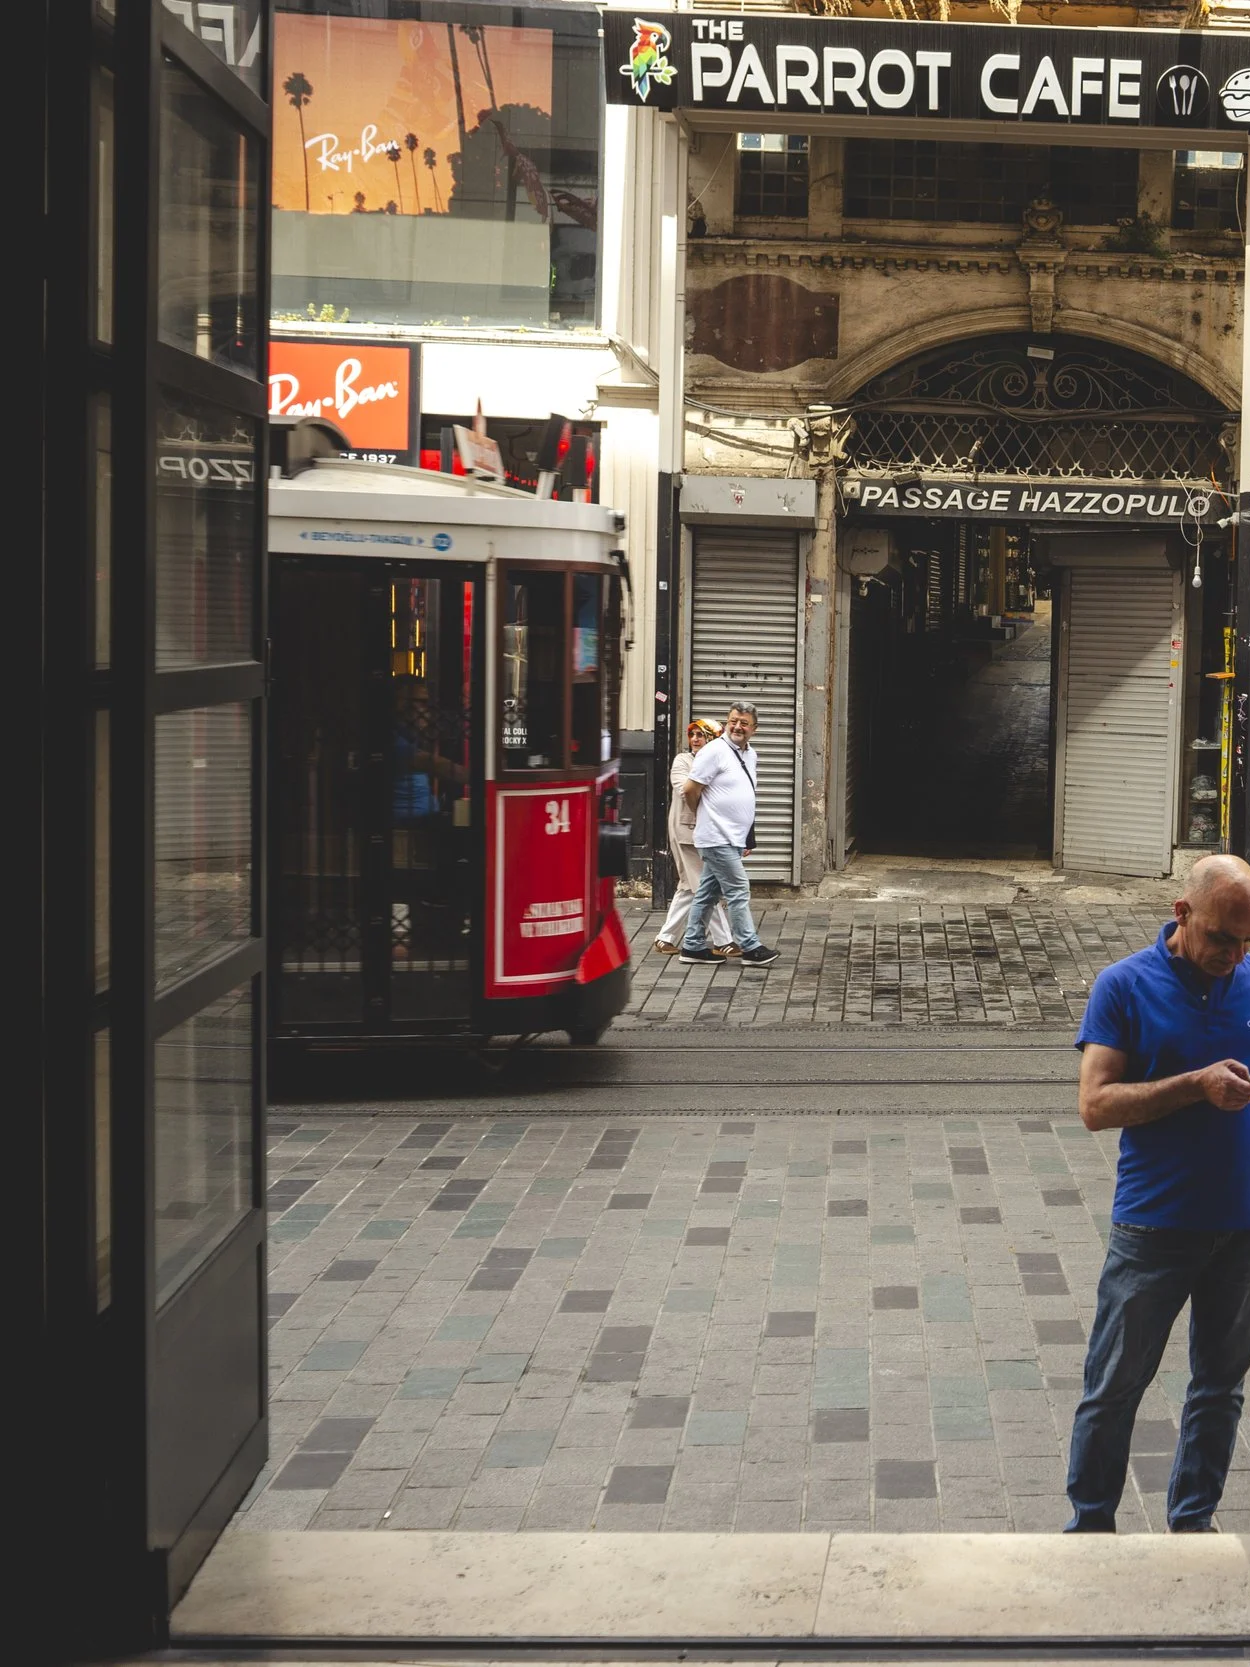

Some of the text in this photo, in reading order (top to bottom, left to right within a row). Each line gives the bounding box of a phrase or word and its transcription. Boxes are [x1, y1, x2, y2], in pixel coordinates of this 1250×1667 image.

[692, 19, 744, 41] THE
[691, 42, 1143, 119] PARROT CAFE
[860, 486, 1210, 517] PASSAGE HAZZOPULO
[545, 799, 571, 835] 34
